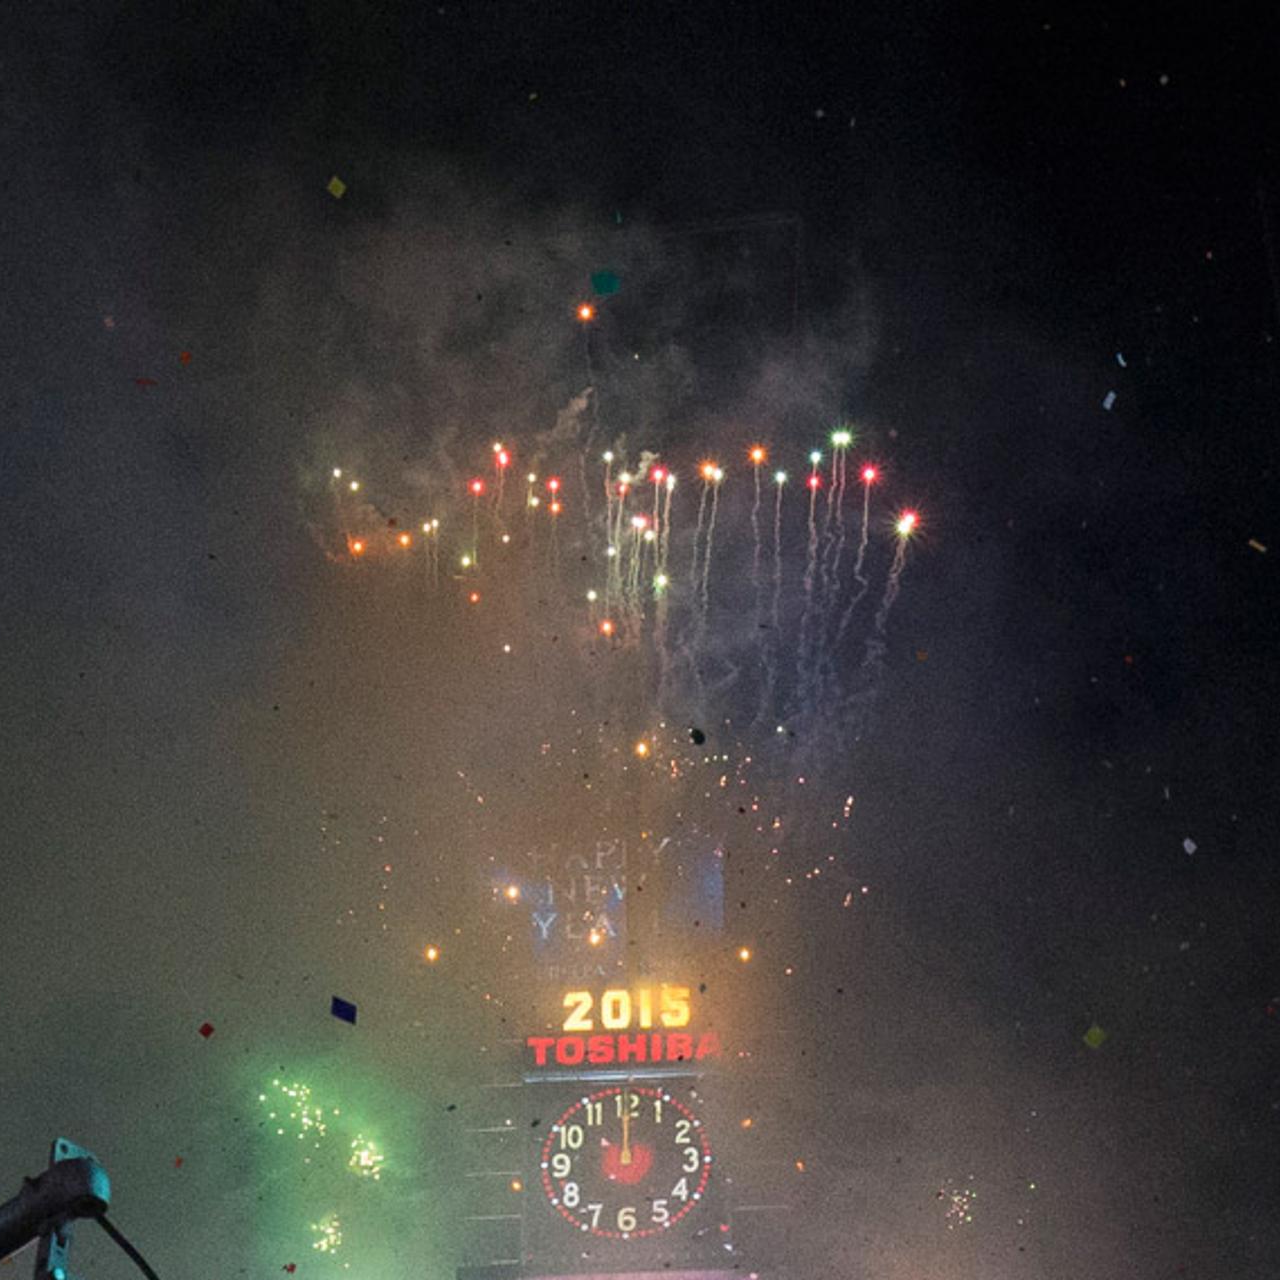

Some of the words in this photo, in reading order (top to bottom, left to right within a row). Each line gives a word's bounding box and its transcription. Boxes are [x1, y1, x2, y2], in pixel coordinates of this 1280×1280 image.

[563, 985, 691, 1032] 2015
[527, 1034, 719, 1067] TOSHIBA
[586, 1101, 603, 1126] 11
[614, 1094, 640, 1118] 12
[653, 1099, 663, 1123] 1
[558, 1124, 583, 1148] 10
[675, 1119, 691, 1144] 2
[551, 1154, 571, 1179] 9
[681, 1146, 700, 1172] 3
[561, 1182, 580, 1207] 8
[671, 1177, 689, 1202] 4
[587, 1204, 603, 1229] 7
[617, 1206, 637, 1232] 6
[651, 1198, 670, 1223] 5
